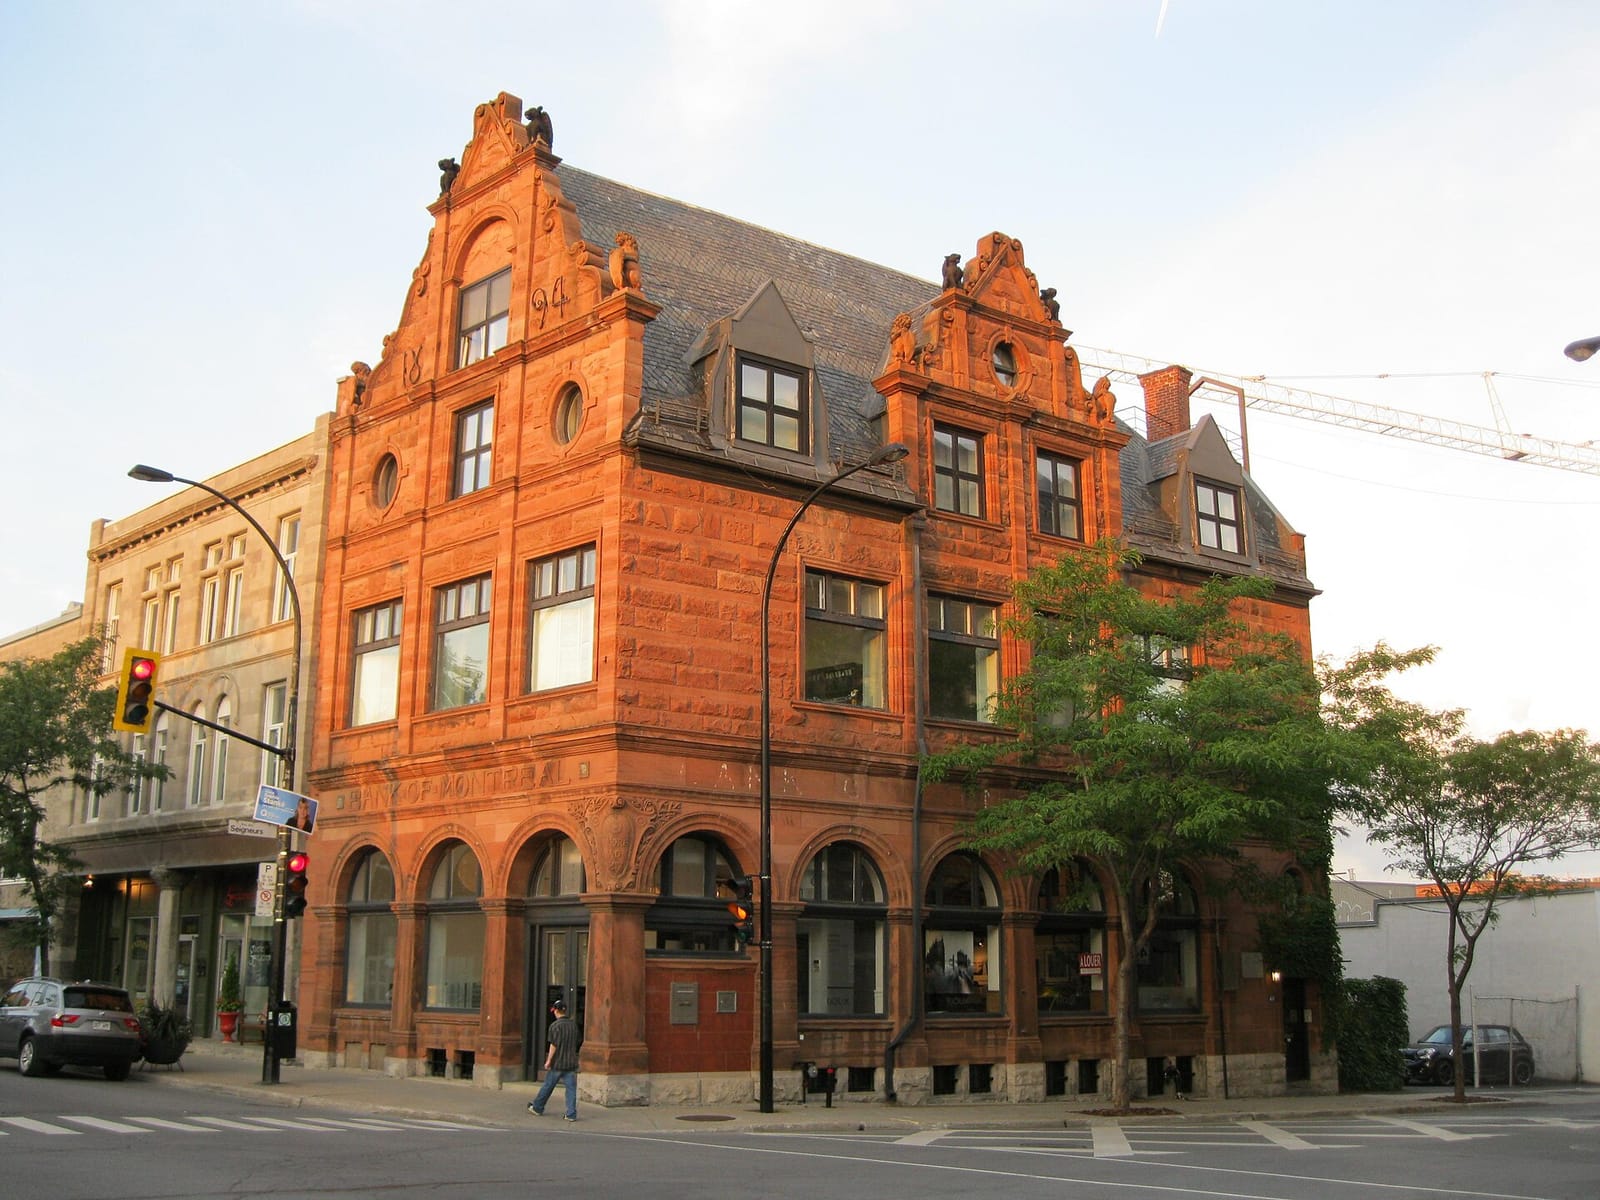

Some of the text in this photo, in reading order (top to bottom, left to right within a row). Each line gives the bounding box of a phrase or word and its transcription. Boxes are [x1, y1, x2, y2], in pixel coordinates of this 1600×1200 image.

[532, 277, 571, 330] 94
[349, 760, 572, 810] BANK OF MONTREAL
[230, 824, 264, 835] Seigneurs
[265, 865, 272, 873] P
[1084, 954, 1102, 967] LOUER
